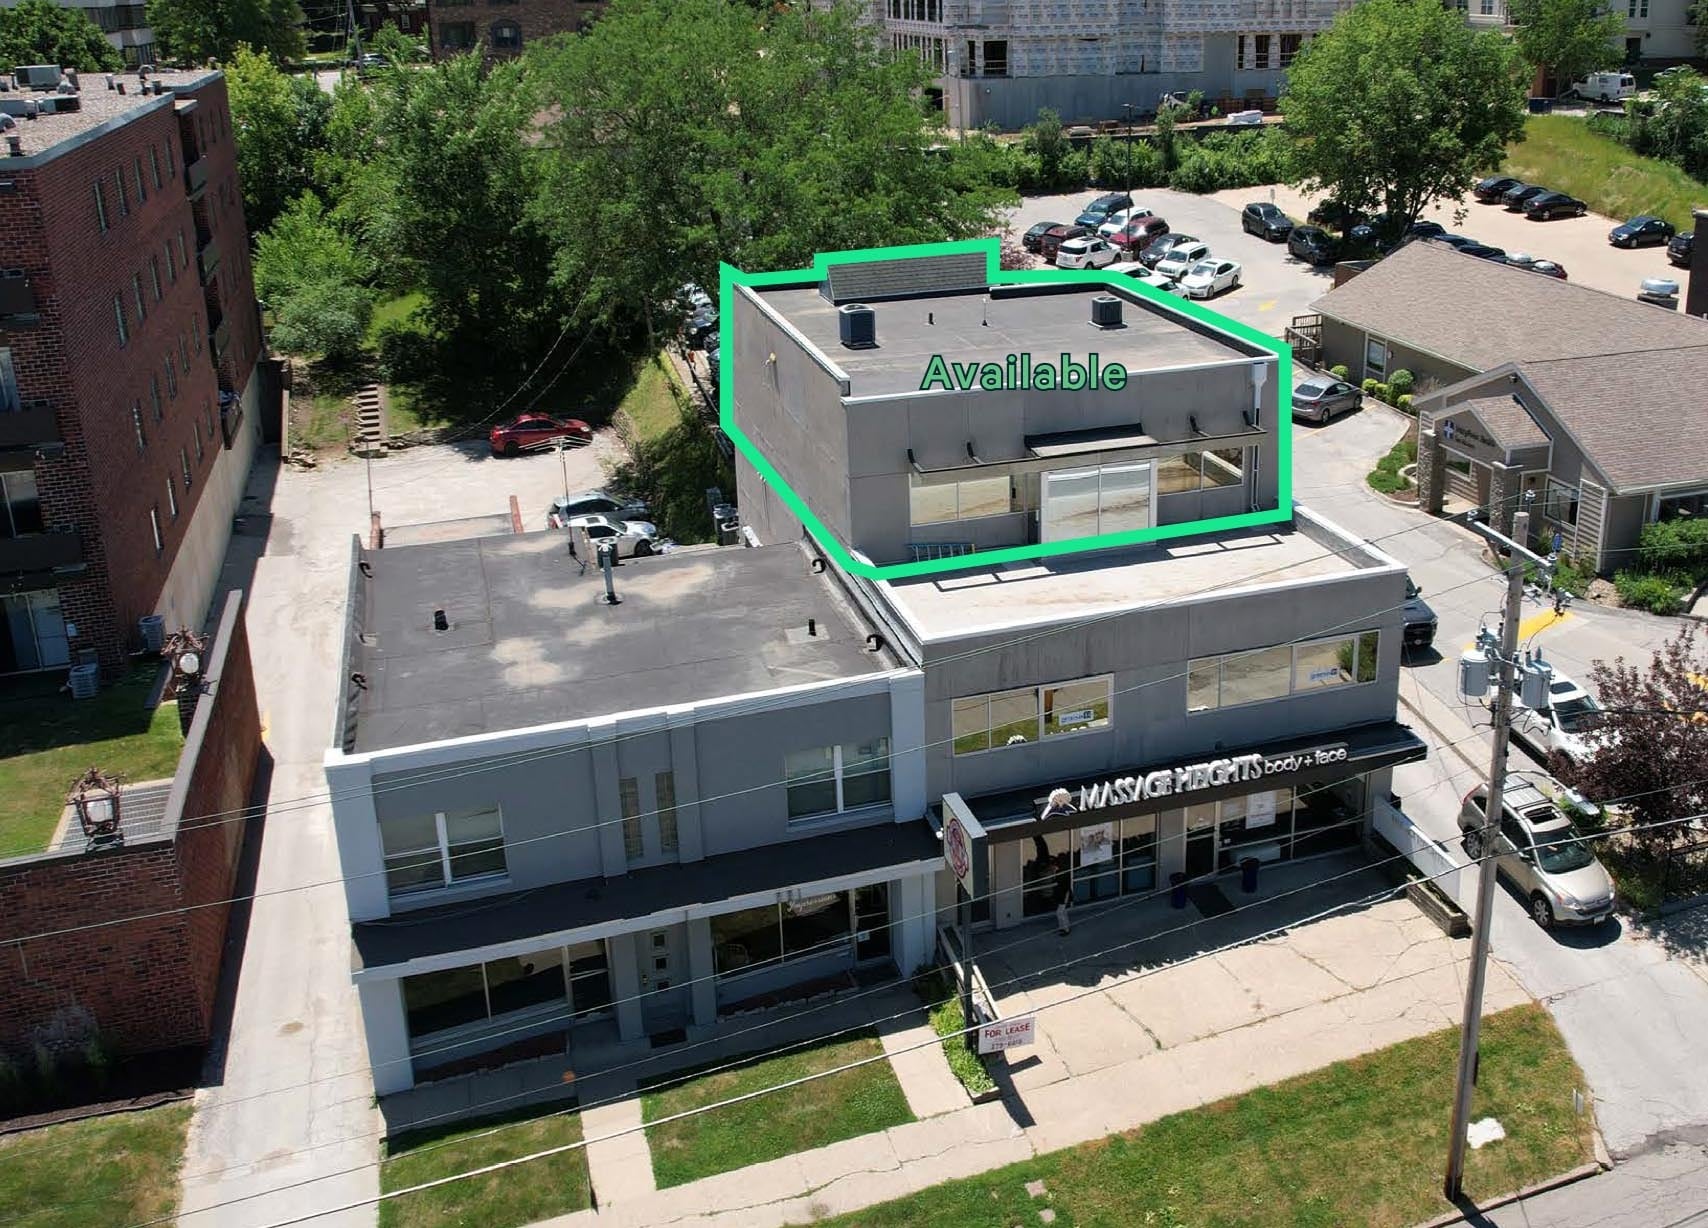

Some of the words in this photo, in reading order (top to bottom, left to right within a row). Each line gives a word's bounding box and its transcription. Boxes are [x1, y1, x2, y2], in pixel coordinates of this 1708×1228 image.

[1079, 769, 1173, 812] MASSAGE
[1174, 753, 1263, 793] HEIGHTS
[1264, 755, 1302, 774] body
[1314, 748, 1347, 765] face
[984, 1029, 1002, 1039] FOR
[1005, 1022, 1031, 1035] LEASE
